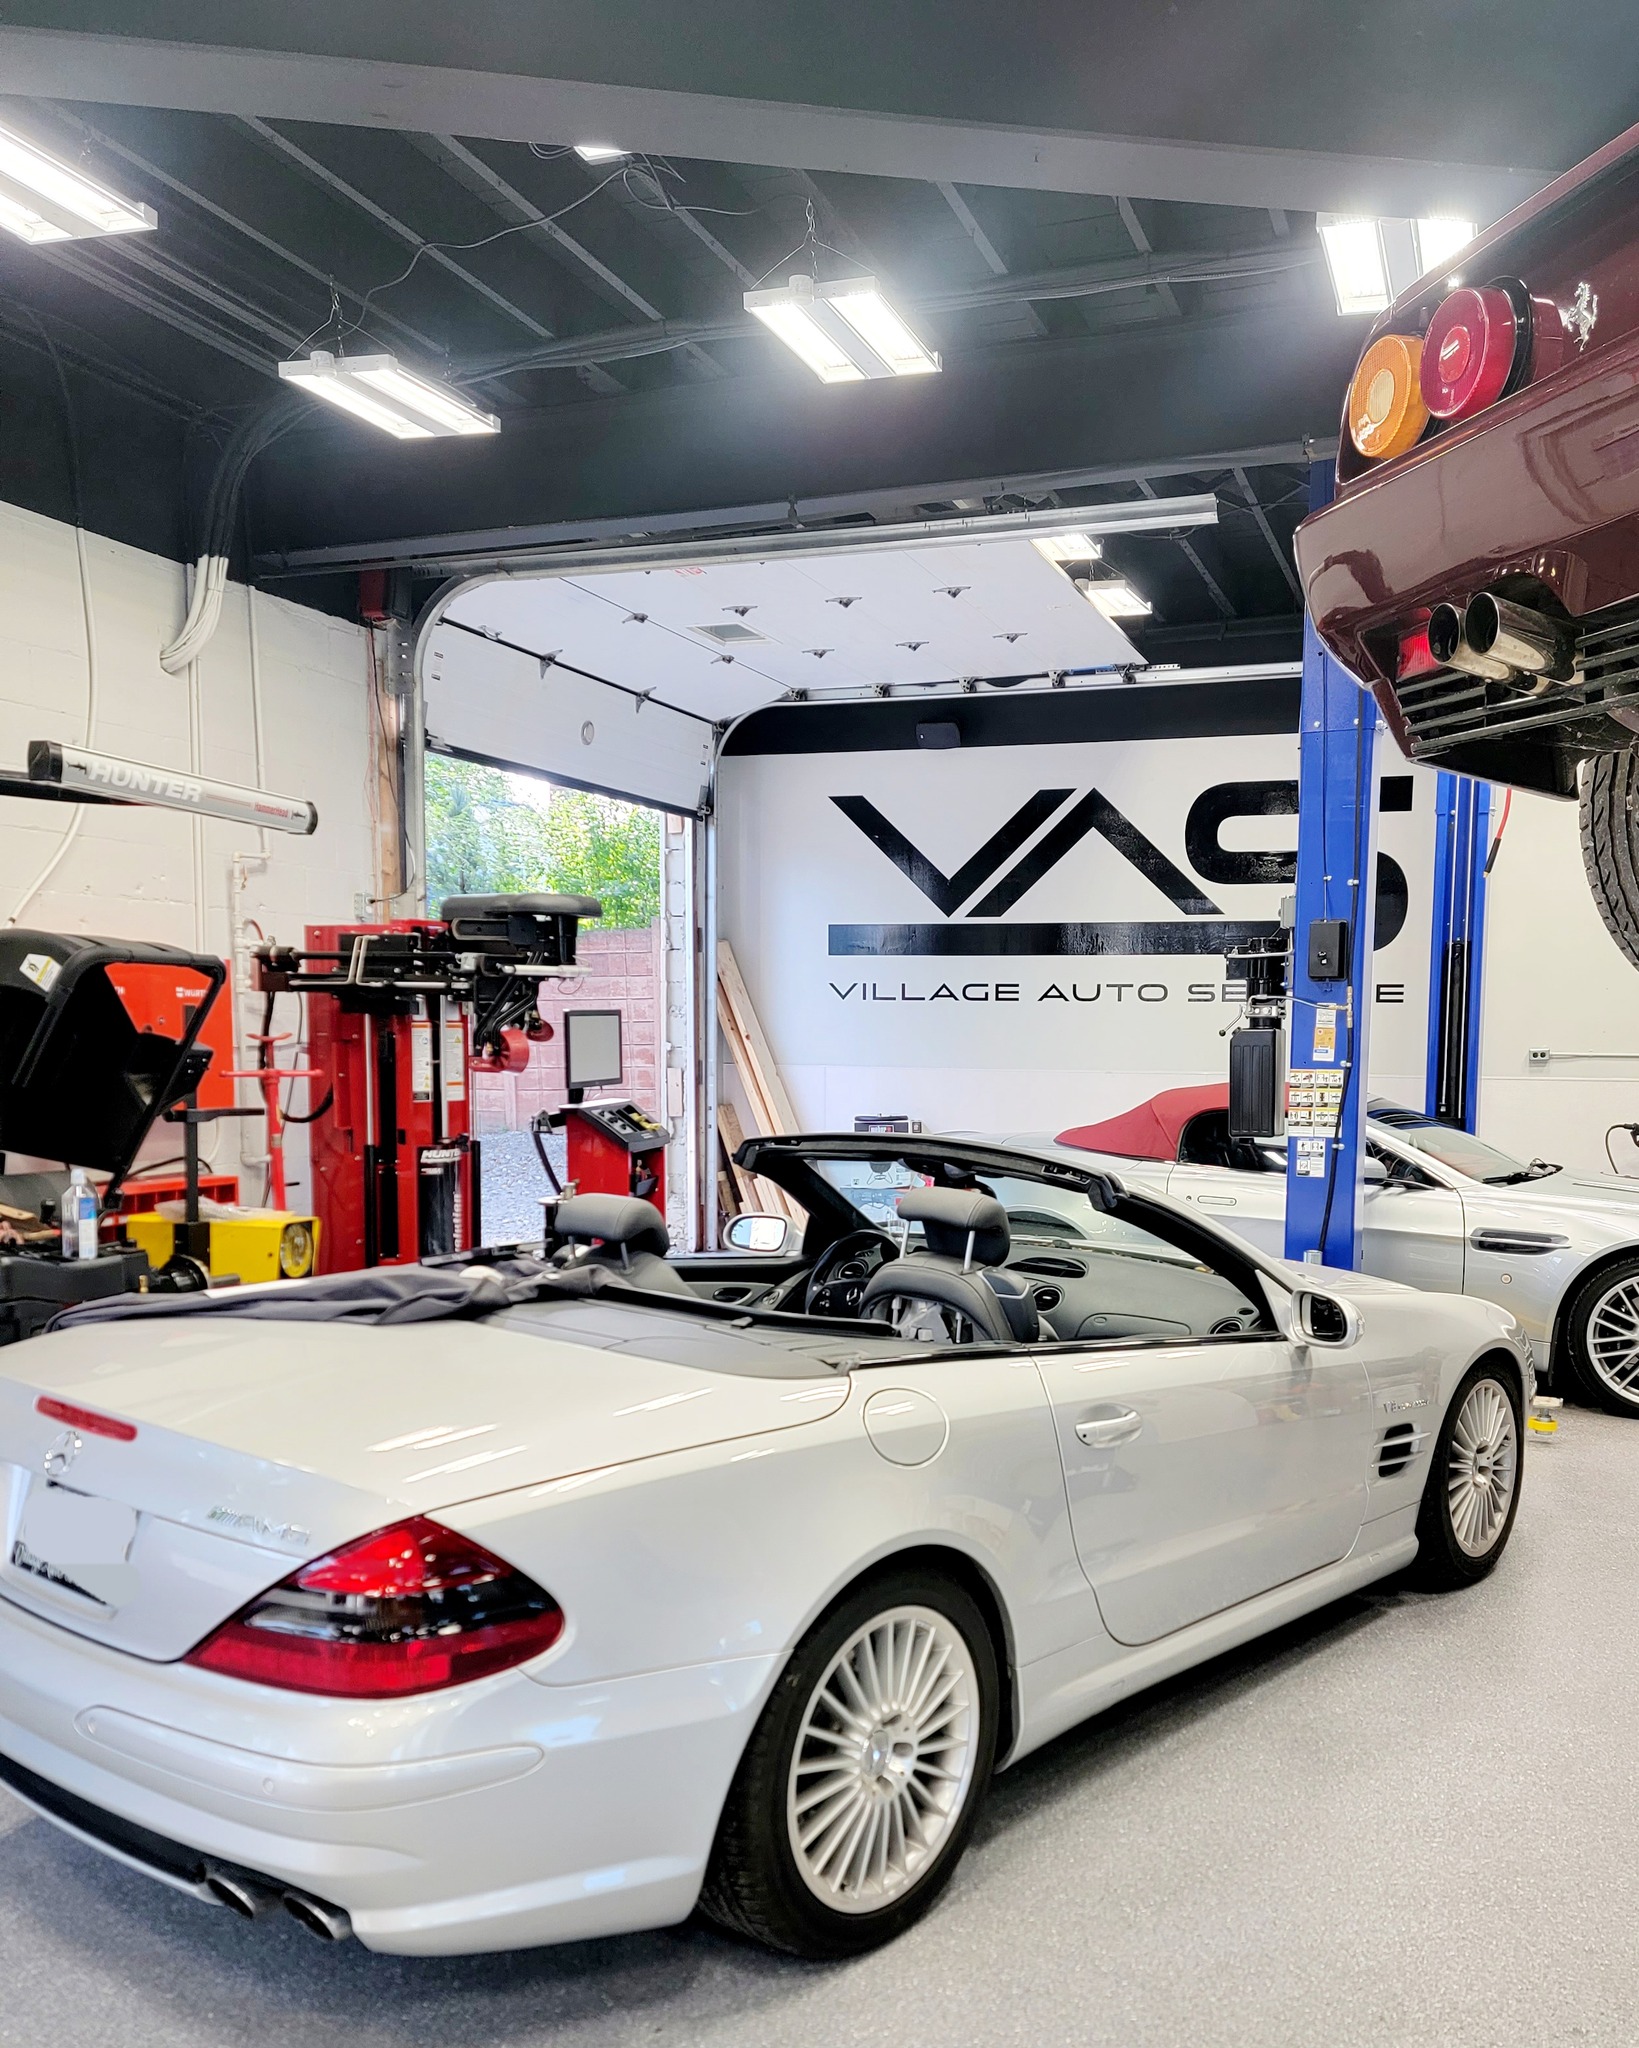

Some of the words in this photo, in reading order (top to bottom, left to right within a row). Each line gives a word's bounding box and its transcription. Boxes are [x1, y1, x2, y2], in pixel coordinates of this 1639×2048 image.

[88, 762, 202, 802] HUNTER
[828, 776, 1413, 950] VAS
[829, 982, 1019, 1001] VILLAGE
[1037, 983, 1168, 1002] AUTO
